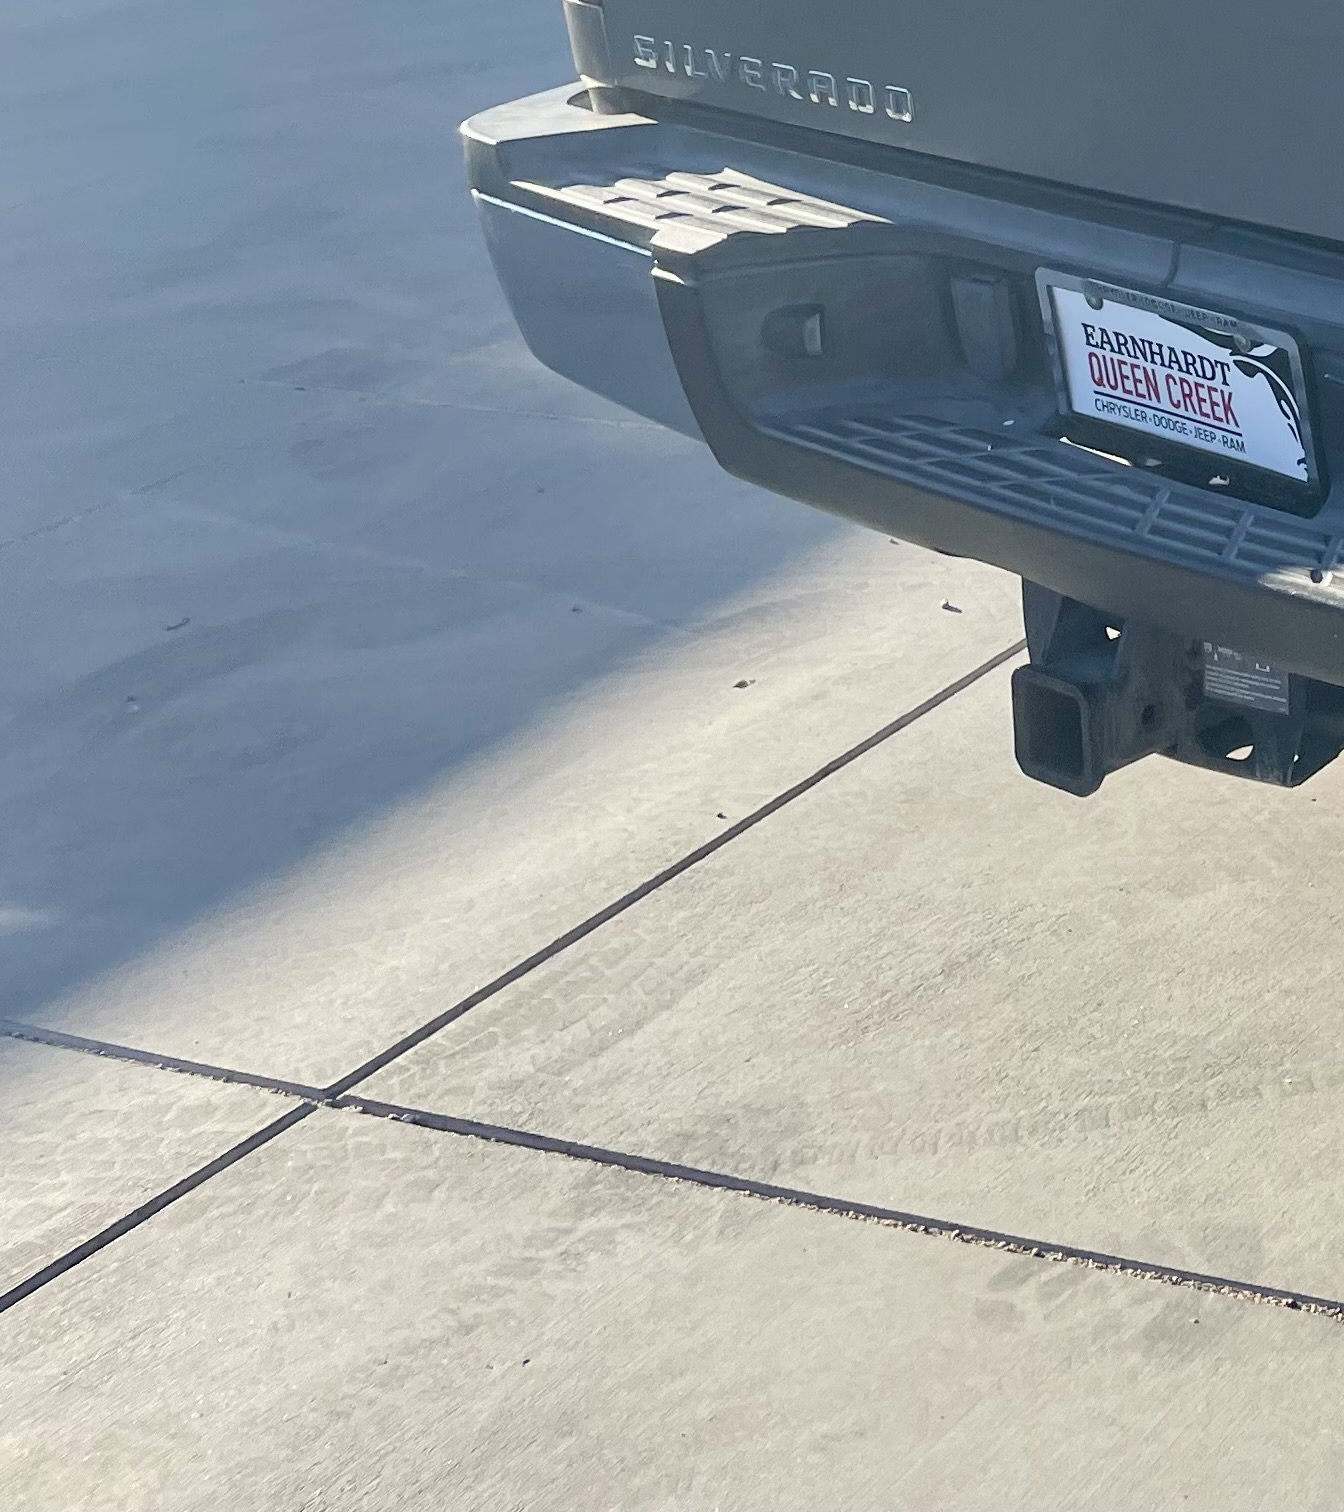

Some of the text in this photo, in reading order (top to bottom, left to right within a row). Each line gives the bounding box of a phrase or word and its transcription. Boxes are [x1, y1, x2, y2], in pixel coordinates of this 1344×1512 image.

[633, 34, 914, 123] SILVERADO
[1081, 322, 1230, 386] EARNHARDT
[1088, 351, 1239, 428] QUEEN CREEK
[1094, 398, 1246, 454] CHRYSLER DODGE JEEP RAM
